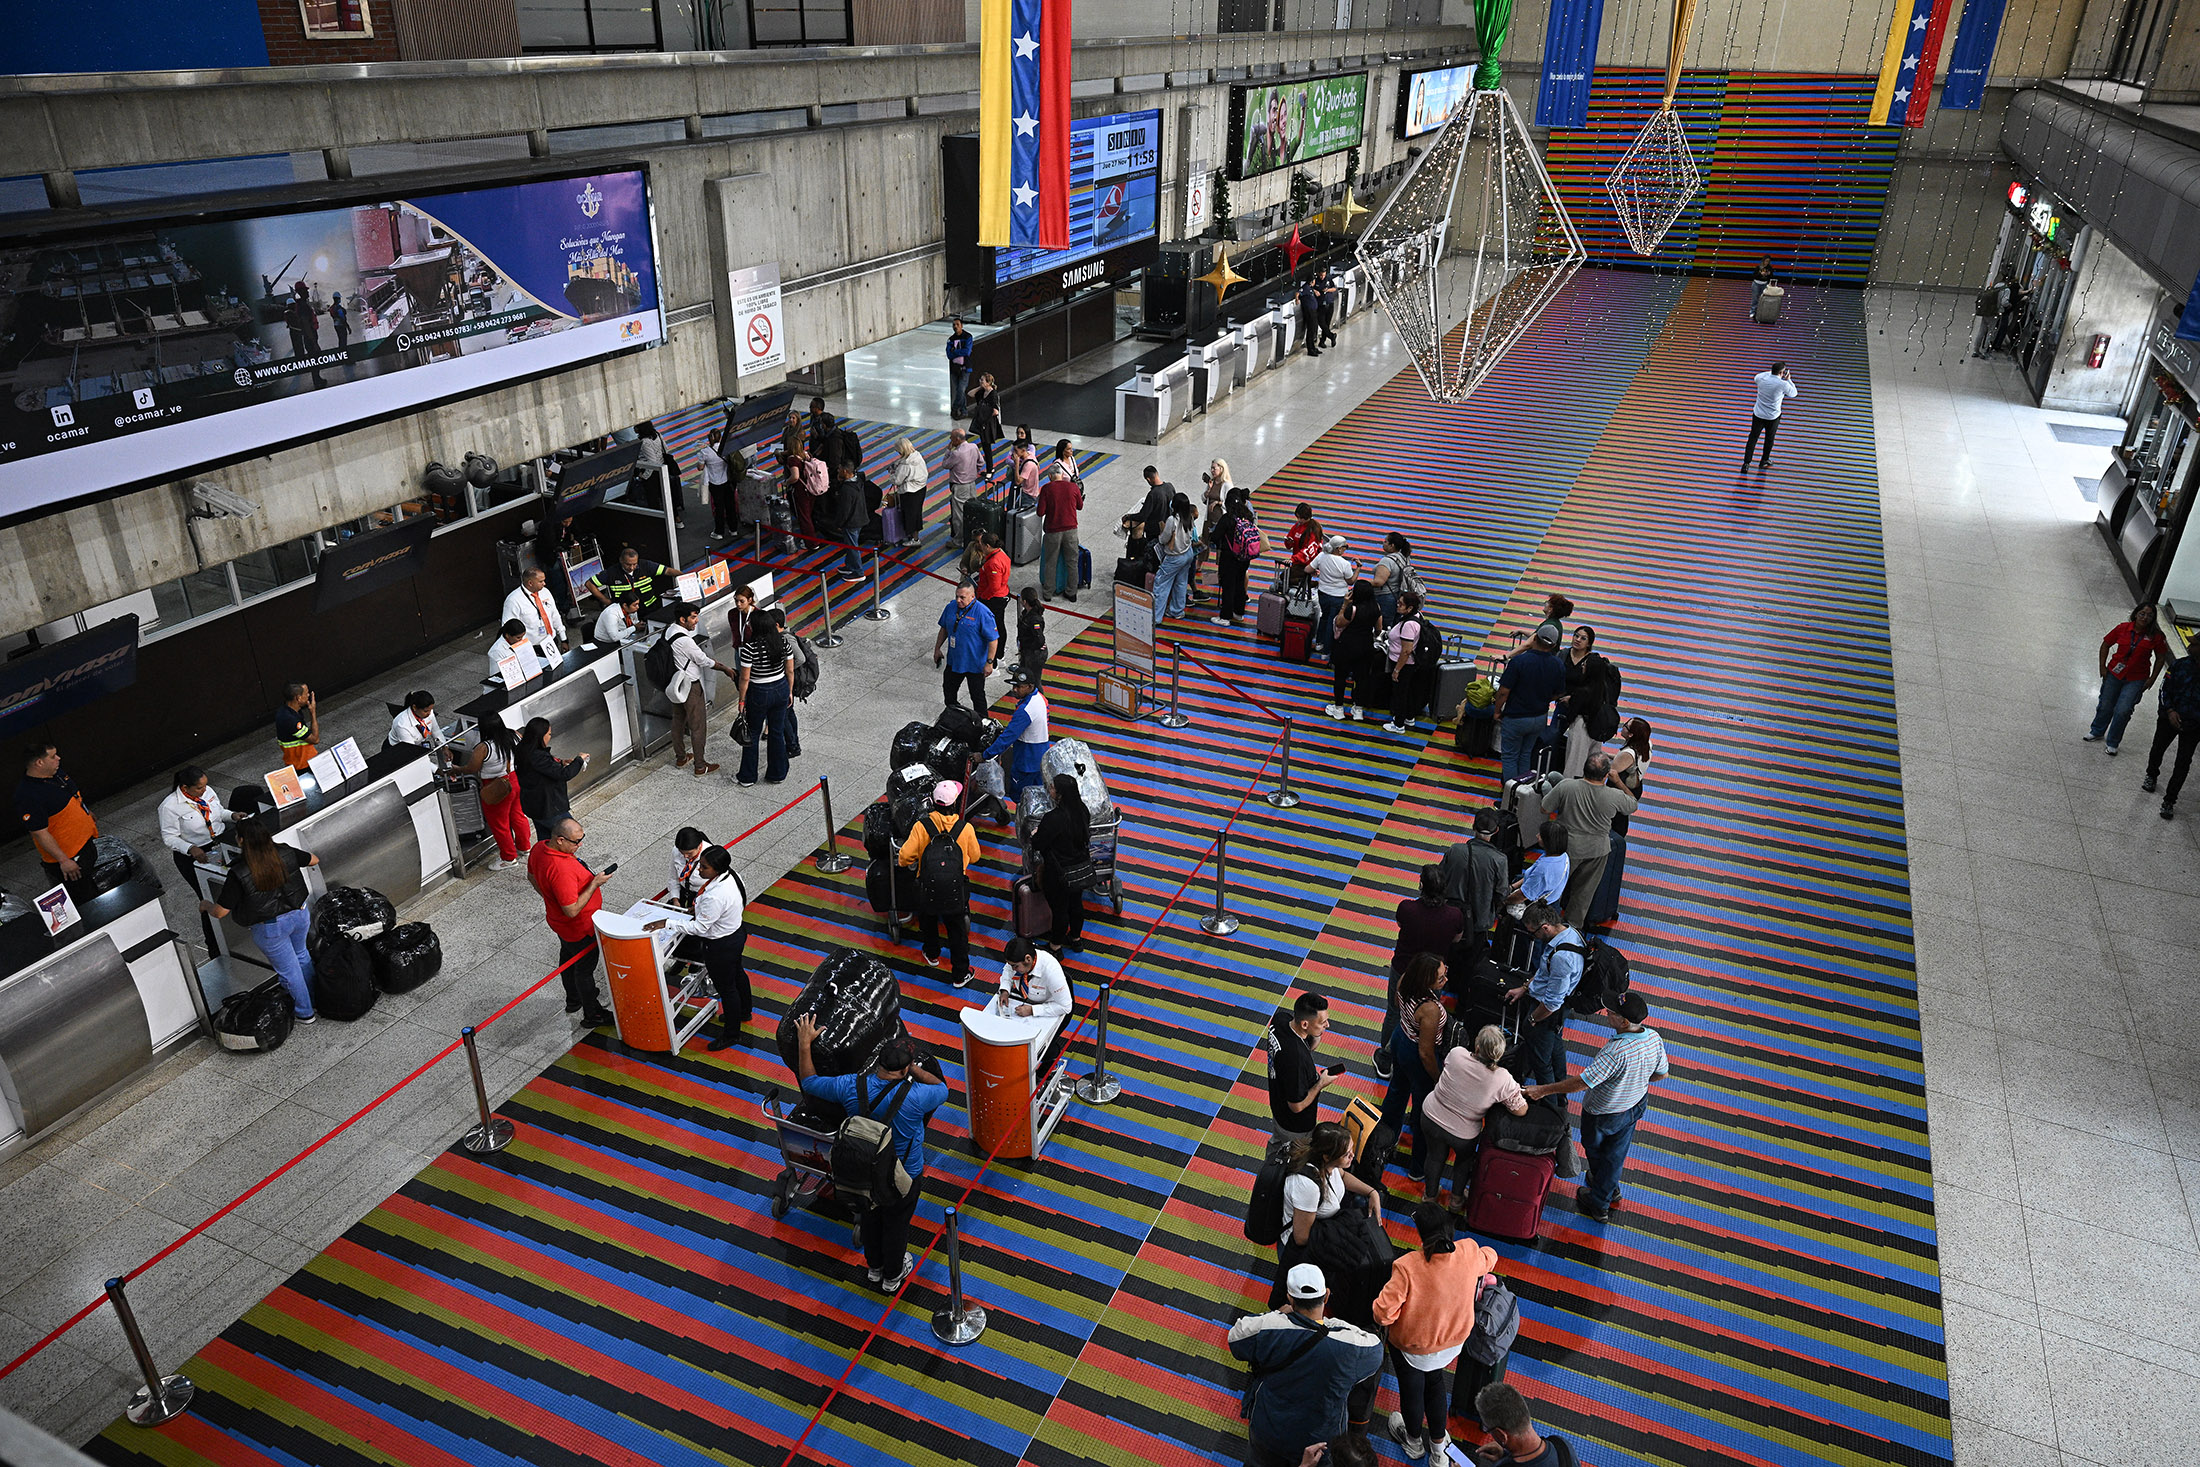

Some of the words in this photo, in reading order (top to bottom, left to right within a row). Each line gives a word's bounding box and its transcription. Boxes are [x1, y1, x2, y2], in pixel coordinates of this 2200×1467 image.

[1112, 160, 1118, 168] 27
[1128, 149, 1155, 168] 11:58
[560, 235, 588, 250] Soluciones
[589, 237, 599, 247] que
[601, 230, 625, 243] Navegan
[600, 247, 608, 256] del
[609, 243, 624, 257] Mar
[1062, 260, 1104, 289] SAMSUNG
[411, 334, 424, 345] +58
[424, 330, 441, 343] 0424
[442, 328, 454, 340] 185
[454, 324, 472, 338] 0783/
[473, 320, 485, 332] +58
[485, 318, 499, 330] 0424
[500, 315, 511, 327] 273
[512, 312, 527, 325] 9681
[254, 351, 349, 379] WWW.OCAMAR.COM.VE
[54, 410, 71, 424] in
[114, 403, 182, 428] @ocamar_ve
[46, 426, 90, 443] ocamar
